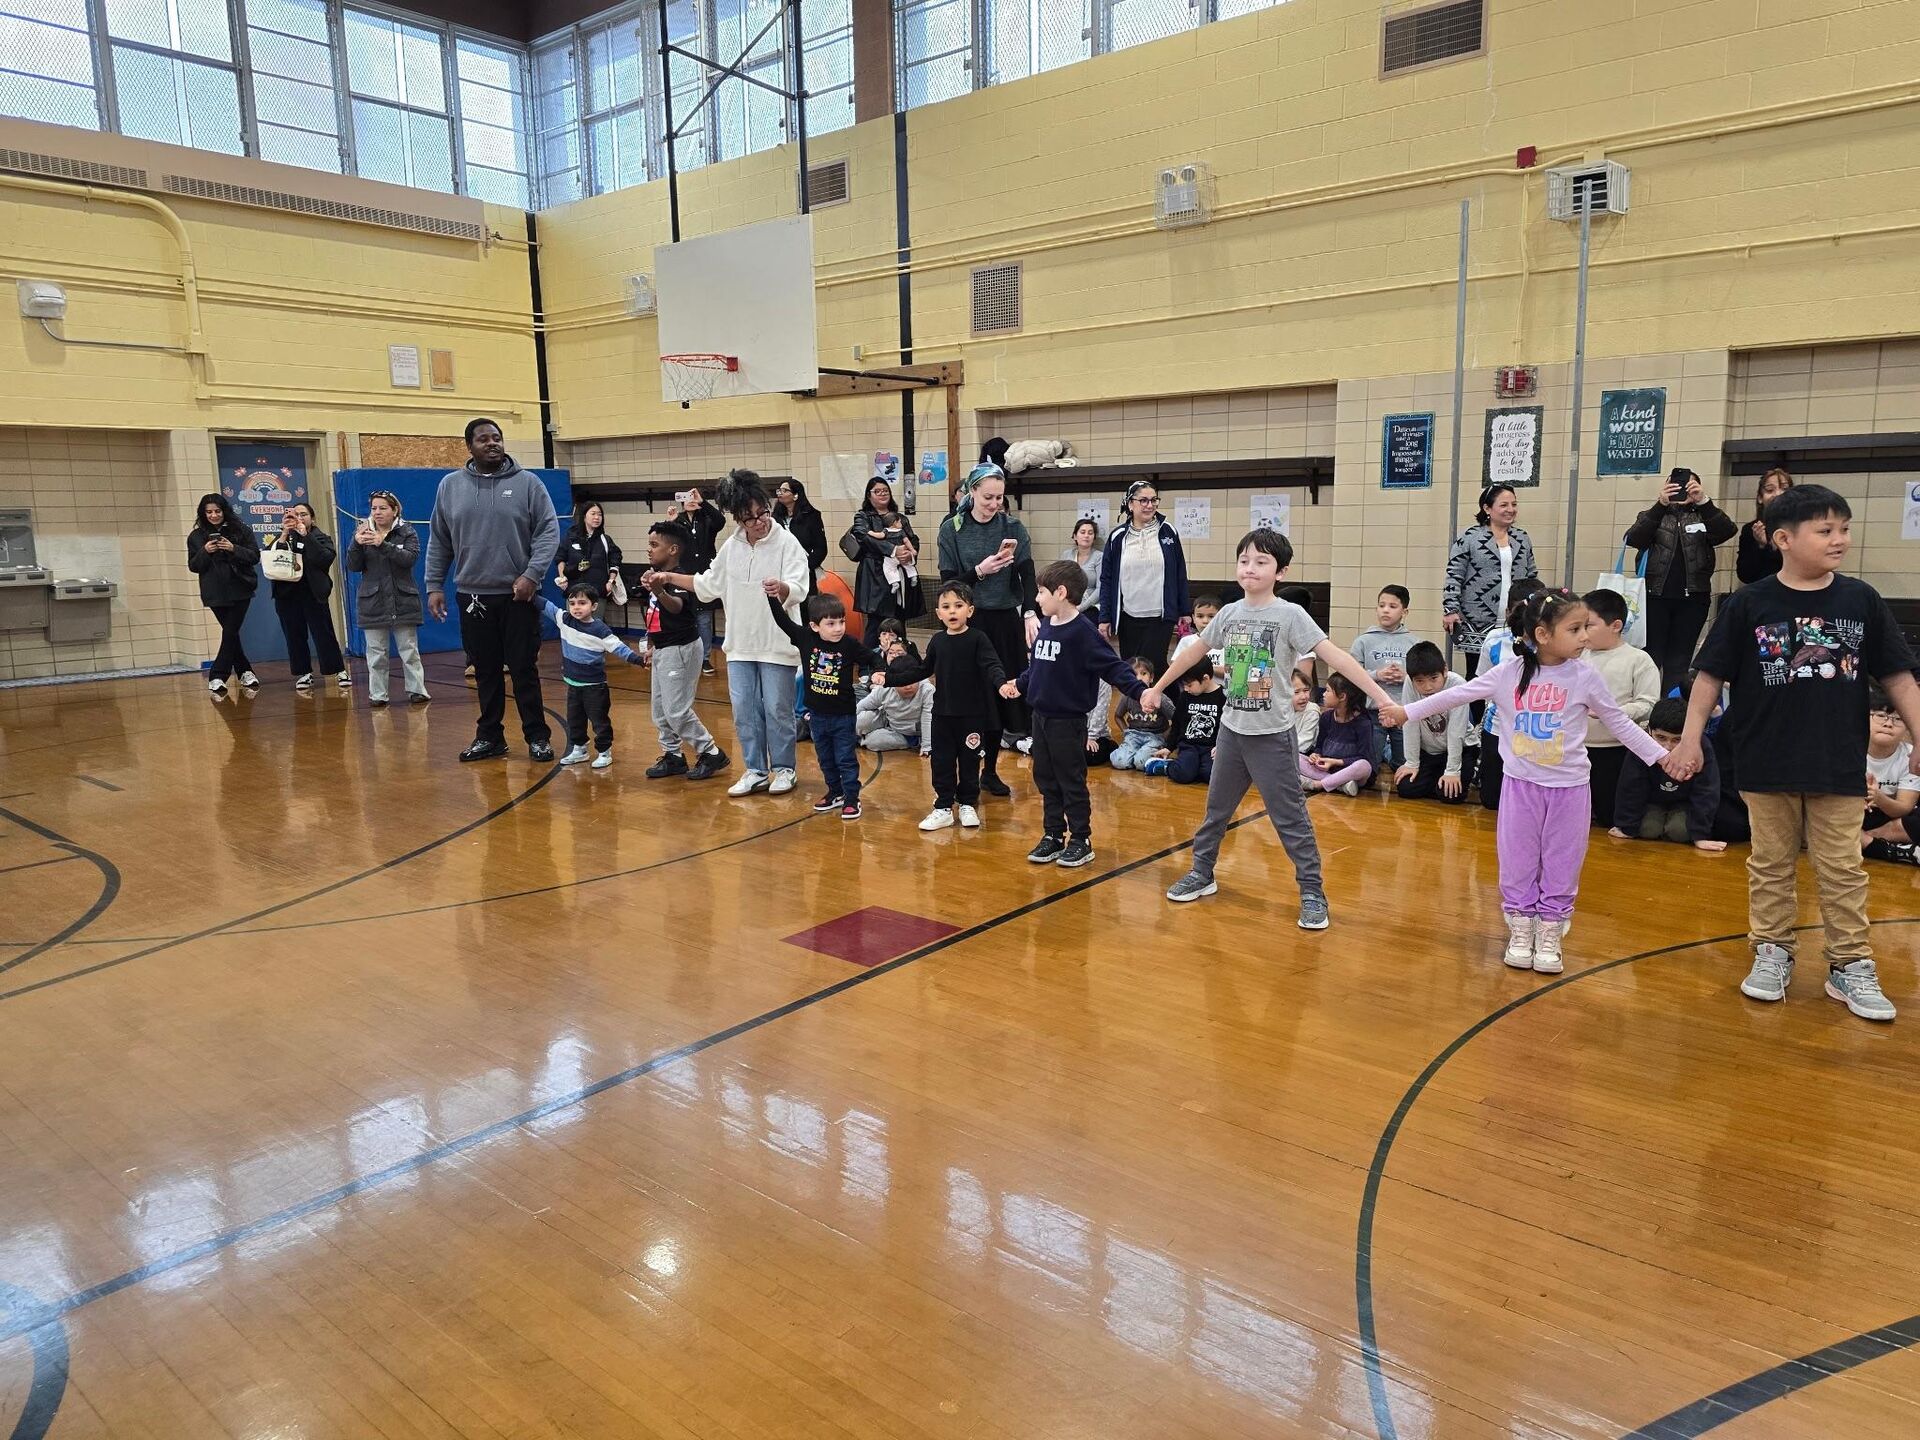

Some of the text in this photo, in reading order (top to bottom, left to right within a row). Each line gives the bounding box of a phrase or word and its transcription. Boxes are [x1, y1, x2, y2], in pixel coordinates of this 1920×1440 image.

[1620, 404, 1658, 421] kind
[1507, 420, 1528, 432] little
[1608, 417, 1656, 434] word
[1495, 431, 1531, 441] progress
[1618, 433, 1655, 449] NEVER
[1493, 438, 1530, 450] each day
[1495, 449, 1528, 458] adds up
[1607, 448, 1655, 460] WASTED
[1499, 455, 1524, 468] to big
[1497, 466, 1525, 475] results
[251, 506, 283, 514] EVERYONE
[1034, 639, 1061, 661] GAP
[817, 652, 833, 674] 5
[1188, 703, 1218, 712] GAMER
[1514, 711, 1562, 739] ALL
